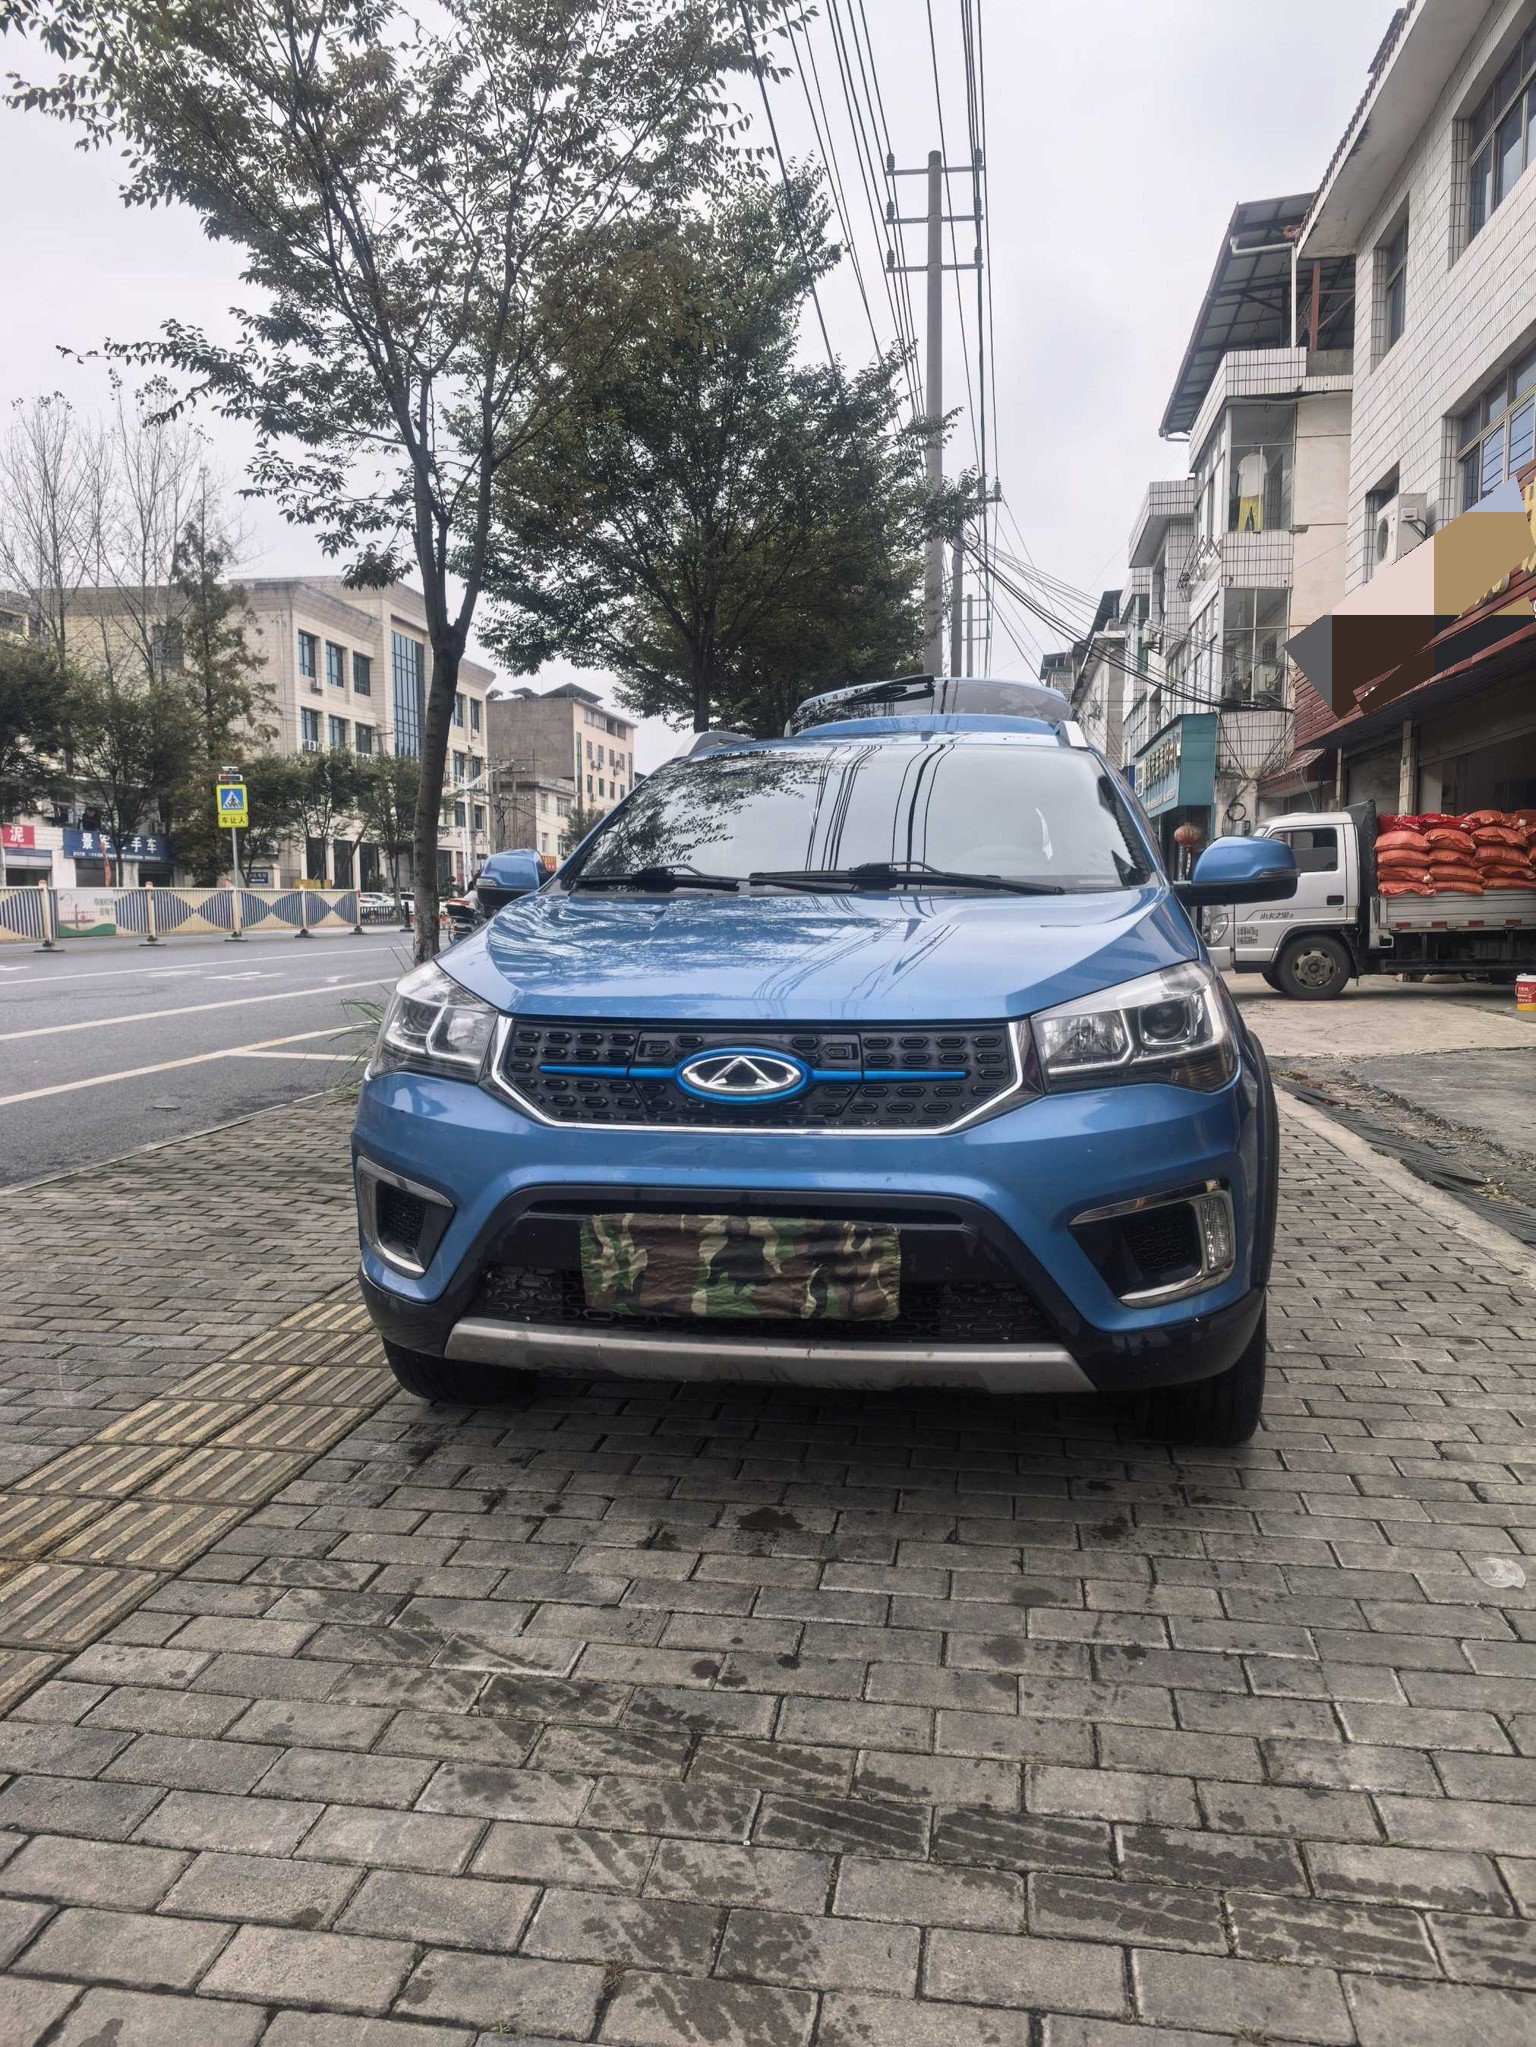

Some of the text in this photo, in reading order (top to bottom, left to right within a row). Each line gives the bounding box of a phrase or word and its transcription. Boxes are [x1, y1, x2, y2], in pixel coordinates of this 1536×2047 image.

[222, 816, 245, 825] 车让人
[9, 825, 25, 843] 泥
